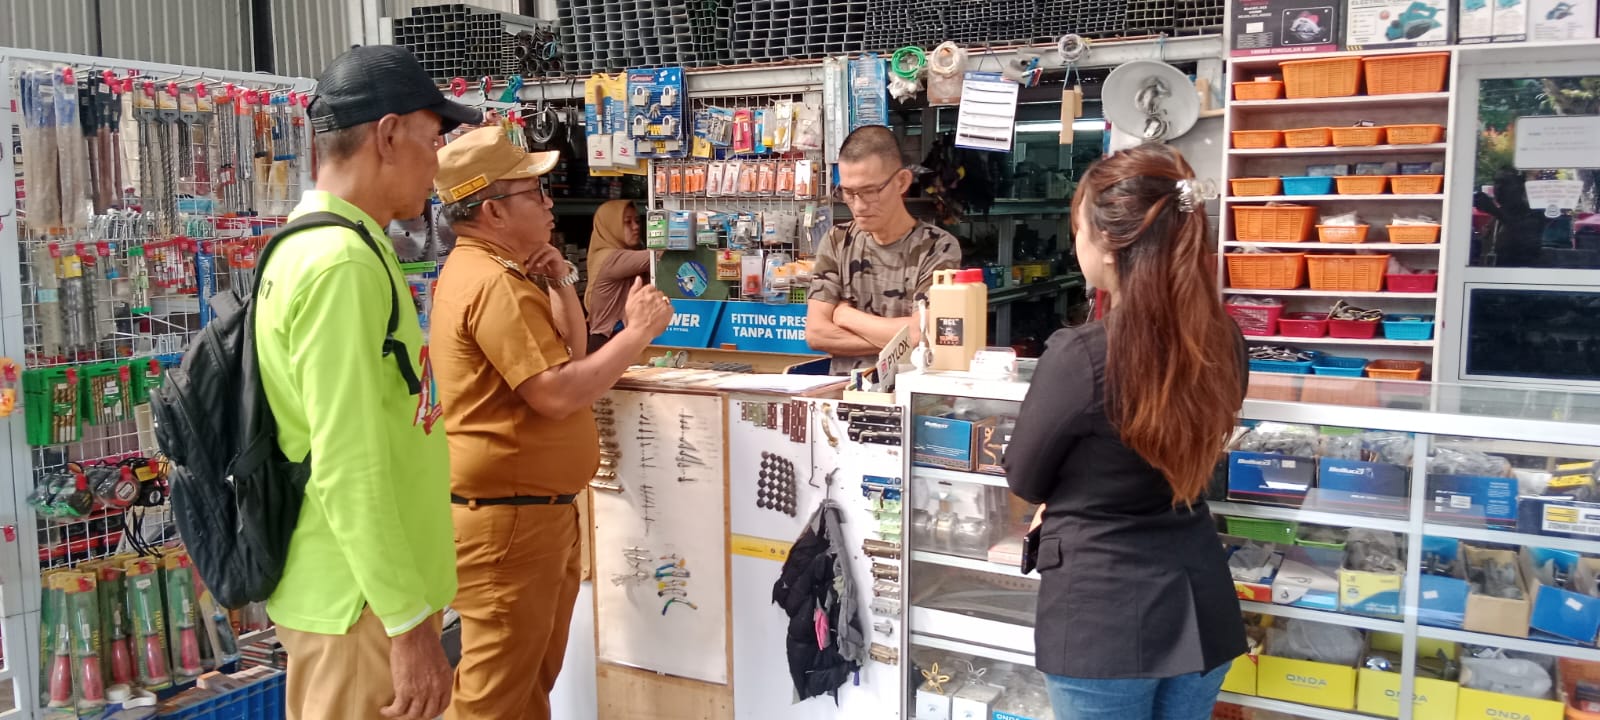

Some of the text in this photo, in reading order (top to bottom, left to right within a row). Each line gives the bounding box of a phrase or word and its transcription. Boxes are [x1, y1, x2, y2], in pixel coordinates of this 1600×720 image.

[668, 313, 700, 327] WER
[731, 313, 807, 327] FITTING PRES
[733, 326, 806, 341] TANPA TIMB
[887, 337, 911, 369] PYLOX
[1286, 674, 1328, 686] ONDA
[1486, 708, 1532, 720] ONDA
